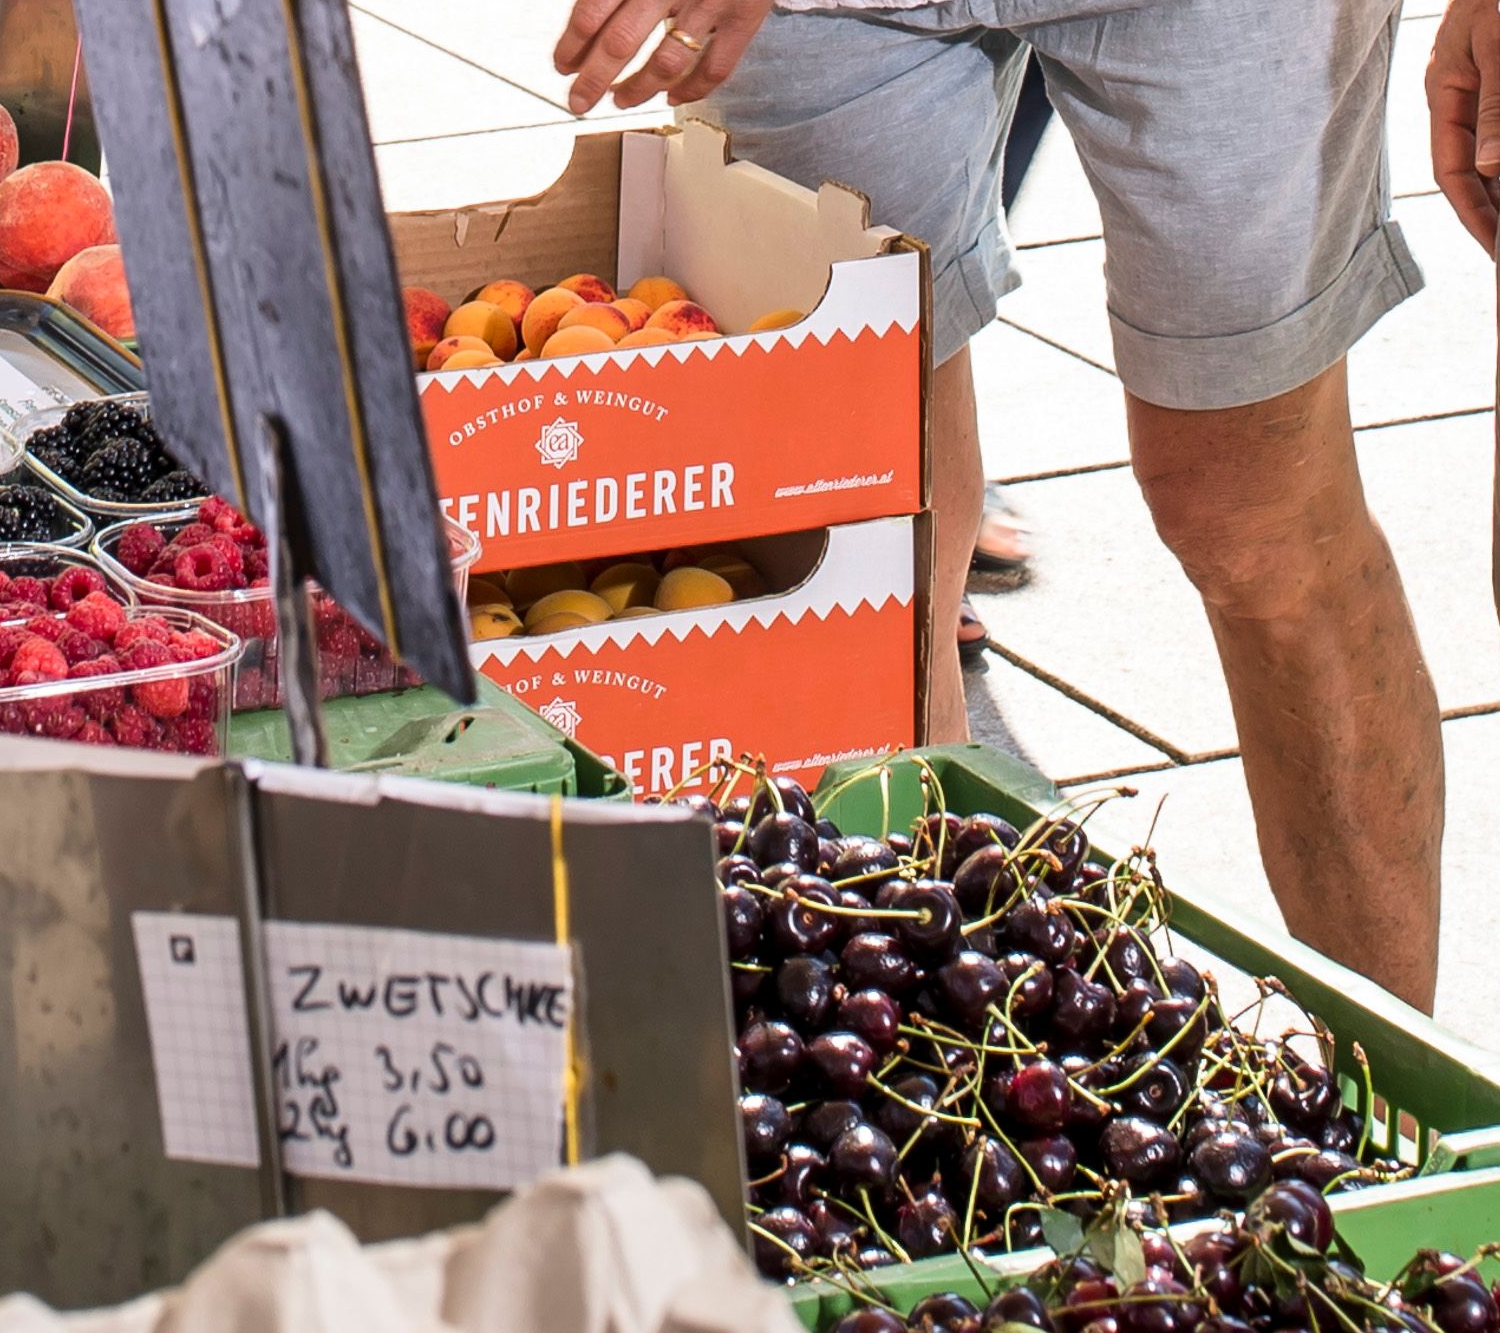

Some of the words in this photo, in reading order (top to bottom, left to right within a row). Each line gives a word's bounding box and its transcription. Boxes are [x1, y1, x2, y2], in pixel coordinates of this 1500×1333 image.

[448, 393, 545, 447] OBSTHOF
[553, 391, 570, 407] &
[575, 389, 670, 424] WEINGUT
[774, 469, 896, 499] www.altenriederer.at
[551, 672, 567, 687] &
[573, 669, 669, 702] WEINGUT
[375, 1039, 486, 1095] 3,50
[385, 1106, 498, 1157] 6,00
